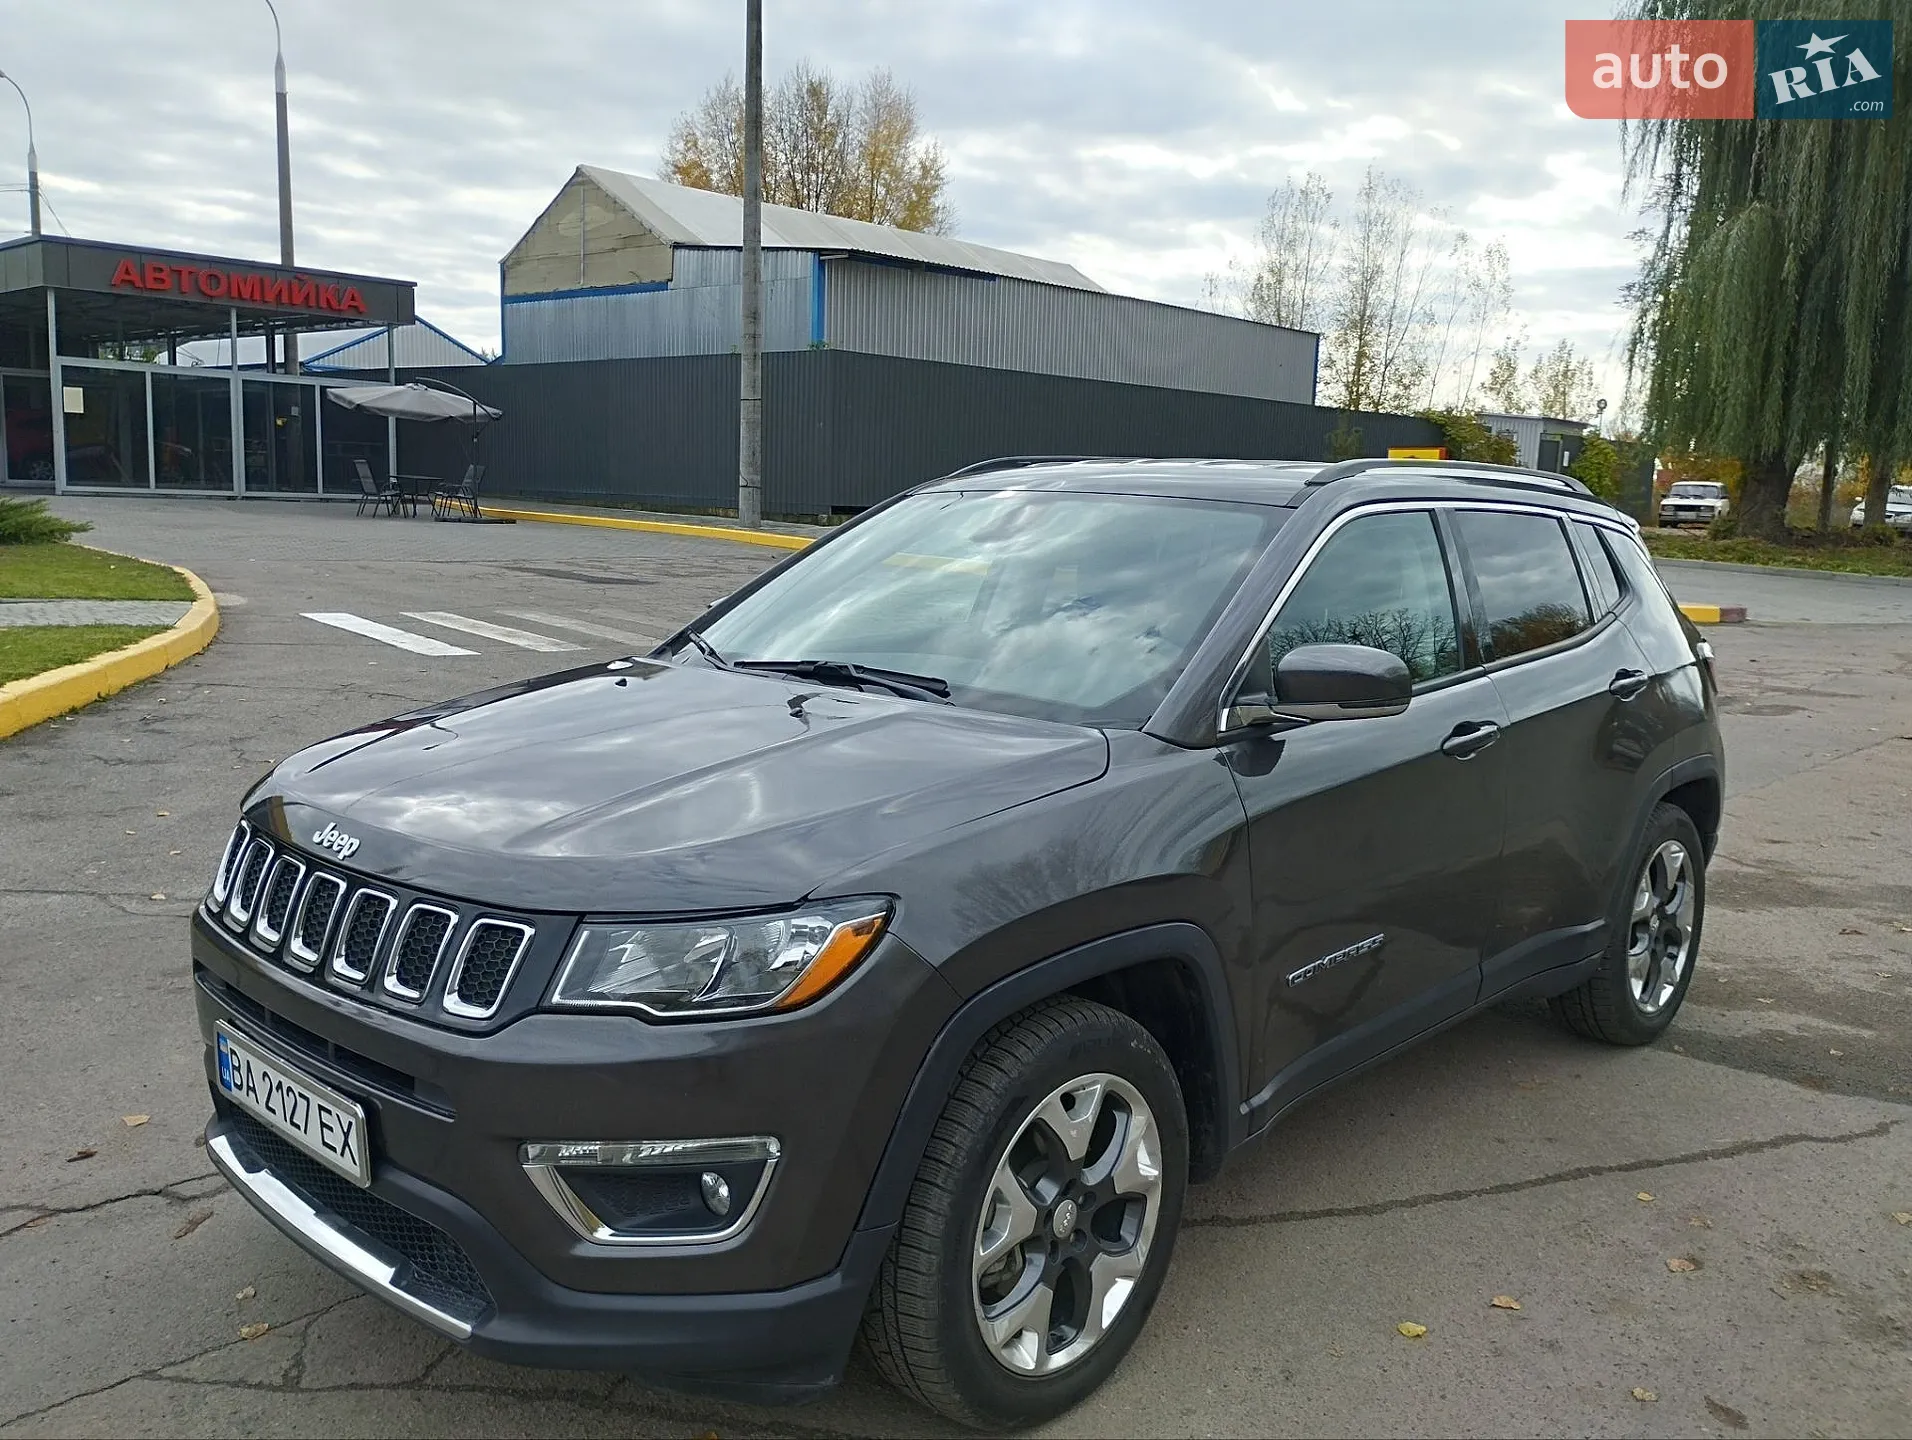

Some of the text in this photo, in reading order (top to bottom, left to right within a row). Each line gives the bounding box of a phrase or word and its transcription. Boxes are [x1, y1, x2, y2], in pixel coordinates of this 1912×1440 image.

[111, 258, 367, 313] АВТОМИЙКА
[312, 821, 361, 860] Jeep
[221, 1066, 231, 1083] UA
[230, 1047, 358, 1166] BA 2127 EX
